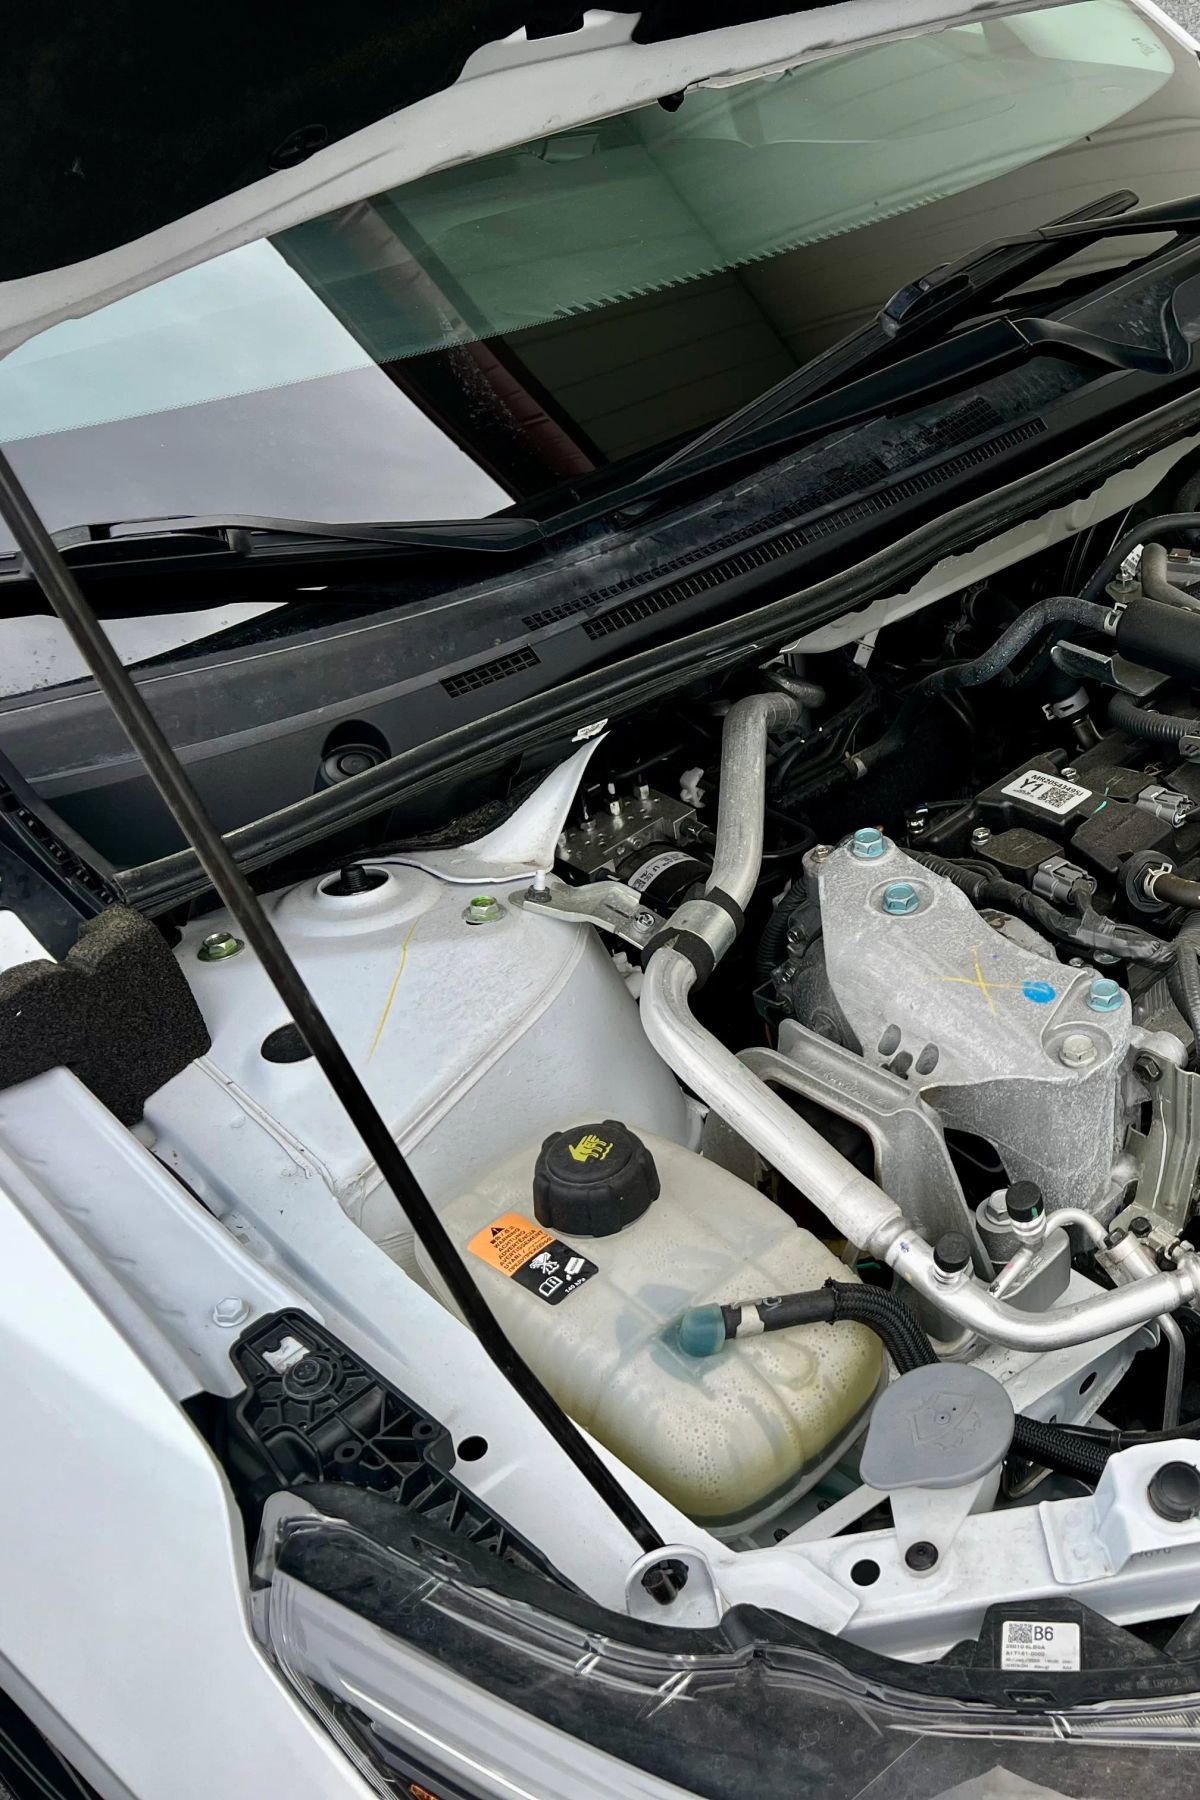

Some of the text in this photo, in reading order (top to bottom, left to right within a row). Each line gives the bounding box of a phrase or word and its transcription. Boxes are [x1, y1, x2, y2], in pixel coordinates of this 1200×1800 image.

[1020, 778, 1043, 792] Y1
[493, 1227, 520, 1248] WARNING
[498, 1230, 525, 1251] ACHTUNG
[499, 1230, 543, 1266] AVERTISSEMENT
[1034, 1626, 1054, 1641] B6
